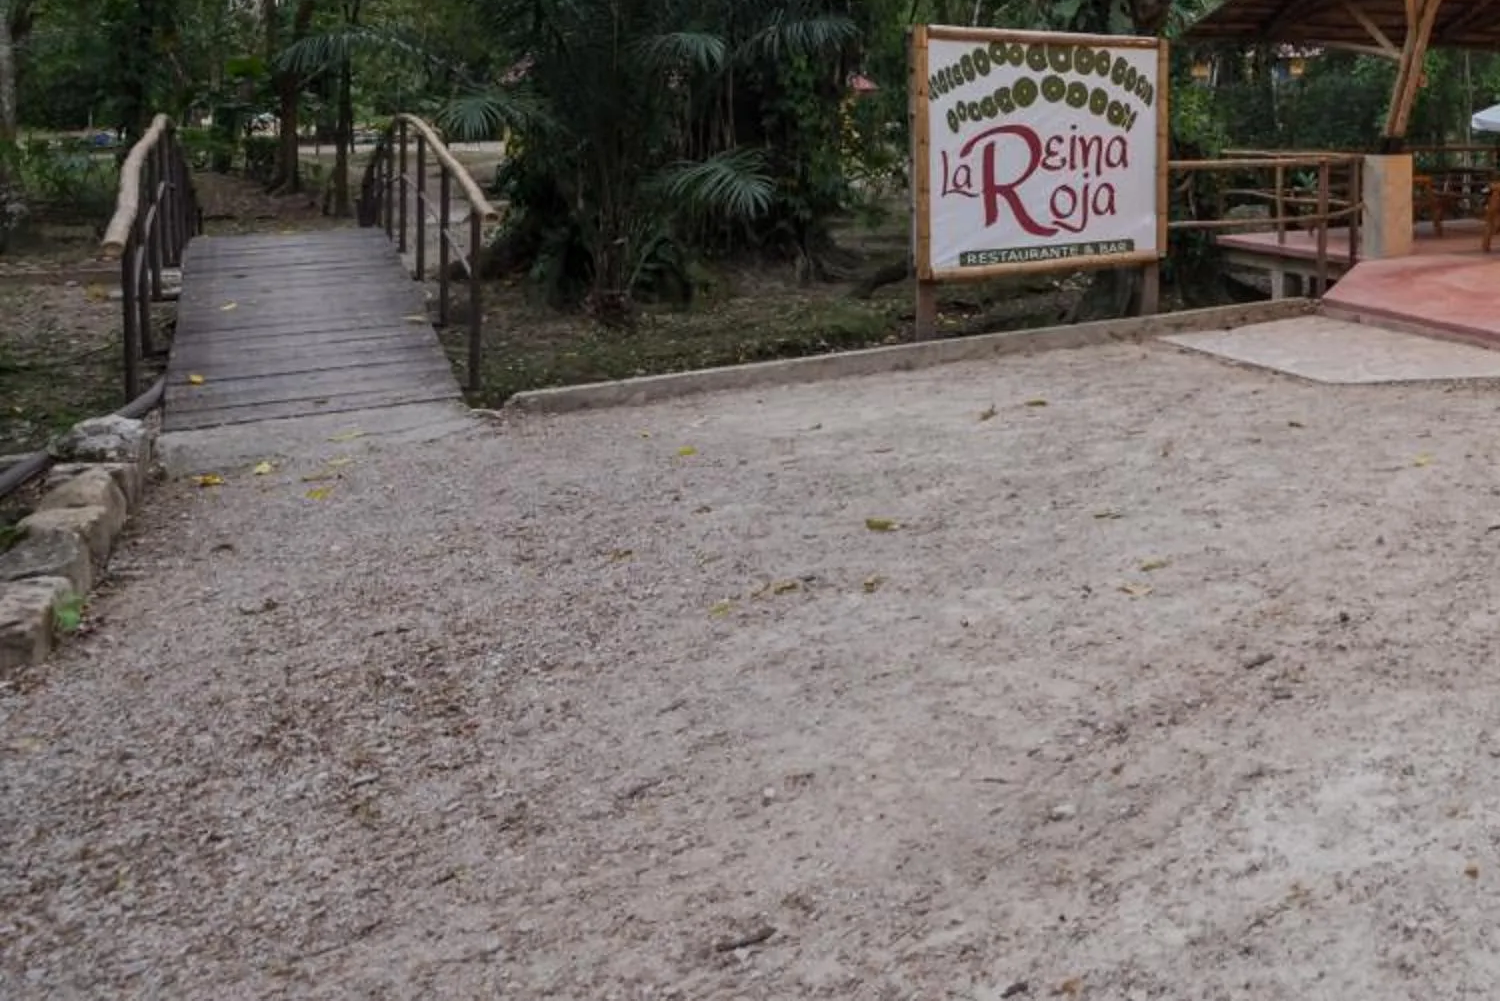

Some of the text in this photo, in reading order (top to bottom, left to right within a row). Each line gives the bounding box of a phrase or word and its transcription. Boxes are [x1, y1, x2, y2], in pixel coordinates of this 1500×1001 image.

[941, 124, 1129, 237] La Reina
[966, 245, 1079, 265] RESTAURANTE
[1100, 241, 1128, 254] BAR
